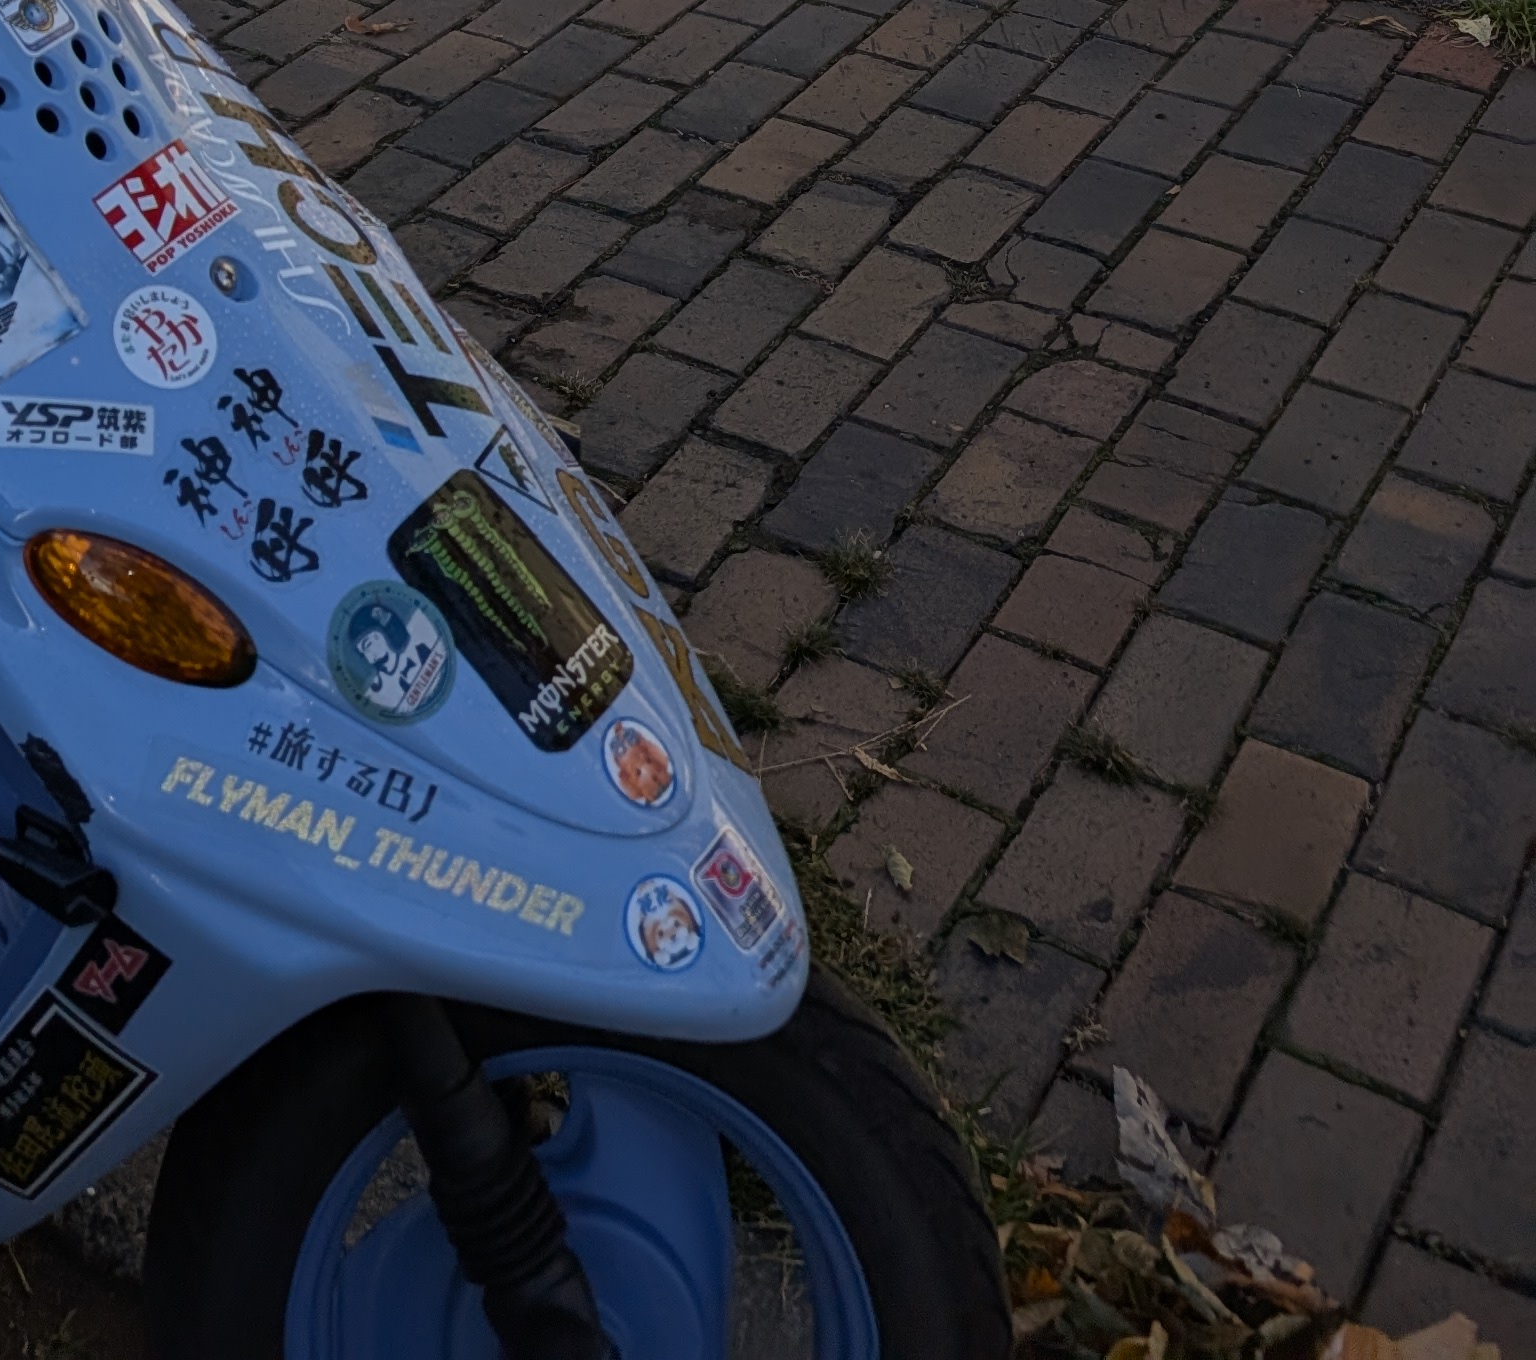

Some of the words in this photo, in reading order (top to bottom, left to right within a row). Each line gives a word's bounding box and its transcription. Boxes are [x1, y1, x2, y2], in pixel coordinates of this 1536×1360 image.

[146, 246, 176, 274] POP
[176, 203, 240, 254] YOSHIOKA
[0, 400, 95, 429] YSP
[96, 406, 147, 435] 筑紫
[5, 428, 139, 450] オフロード部
[518, 622, 621, 733] MONSTER
[247, 720, 440, 823] #旅するBJ
[160, 755, 587, 938] FLYMAN_THUNDER
